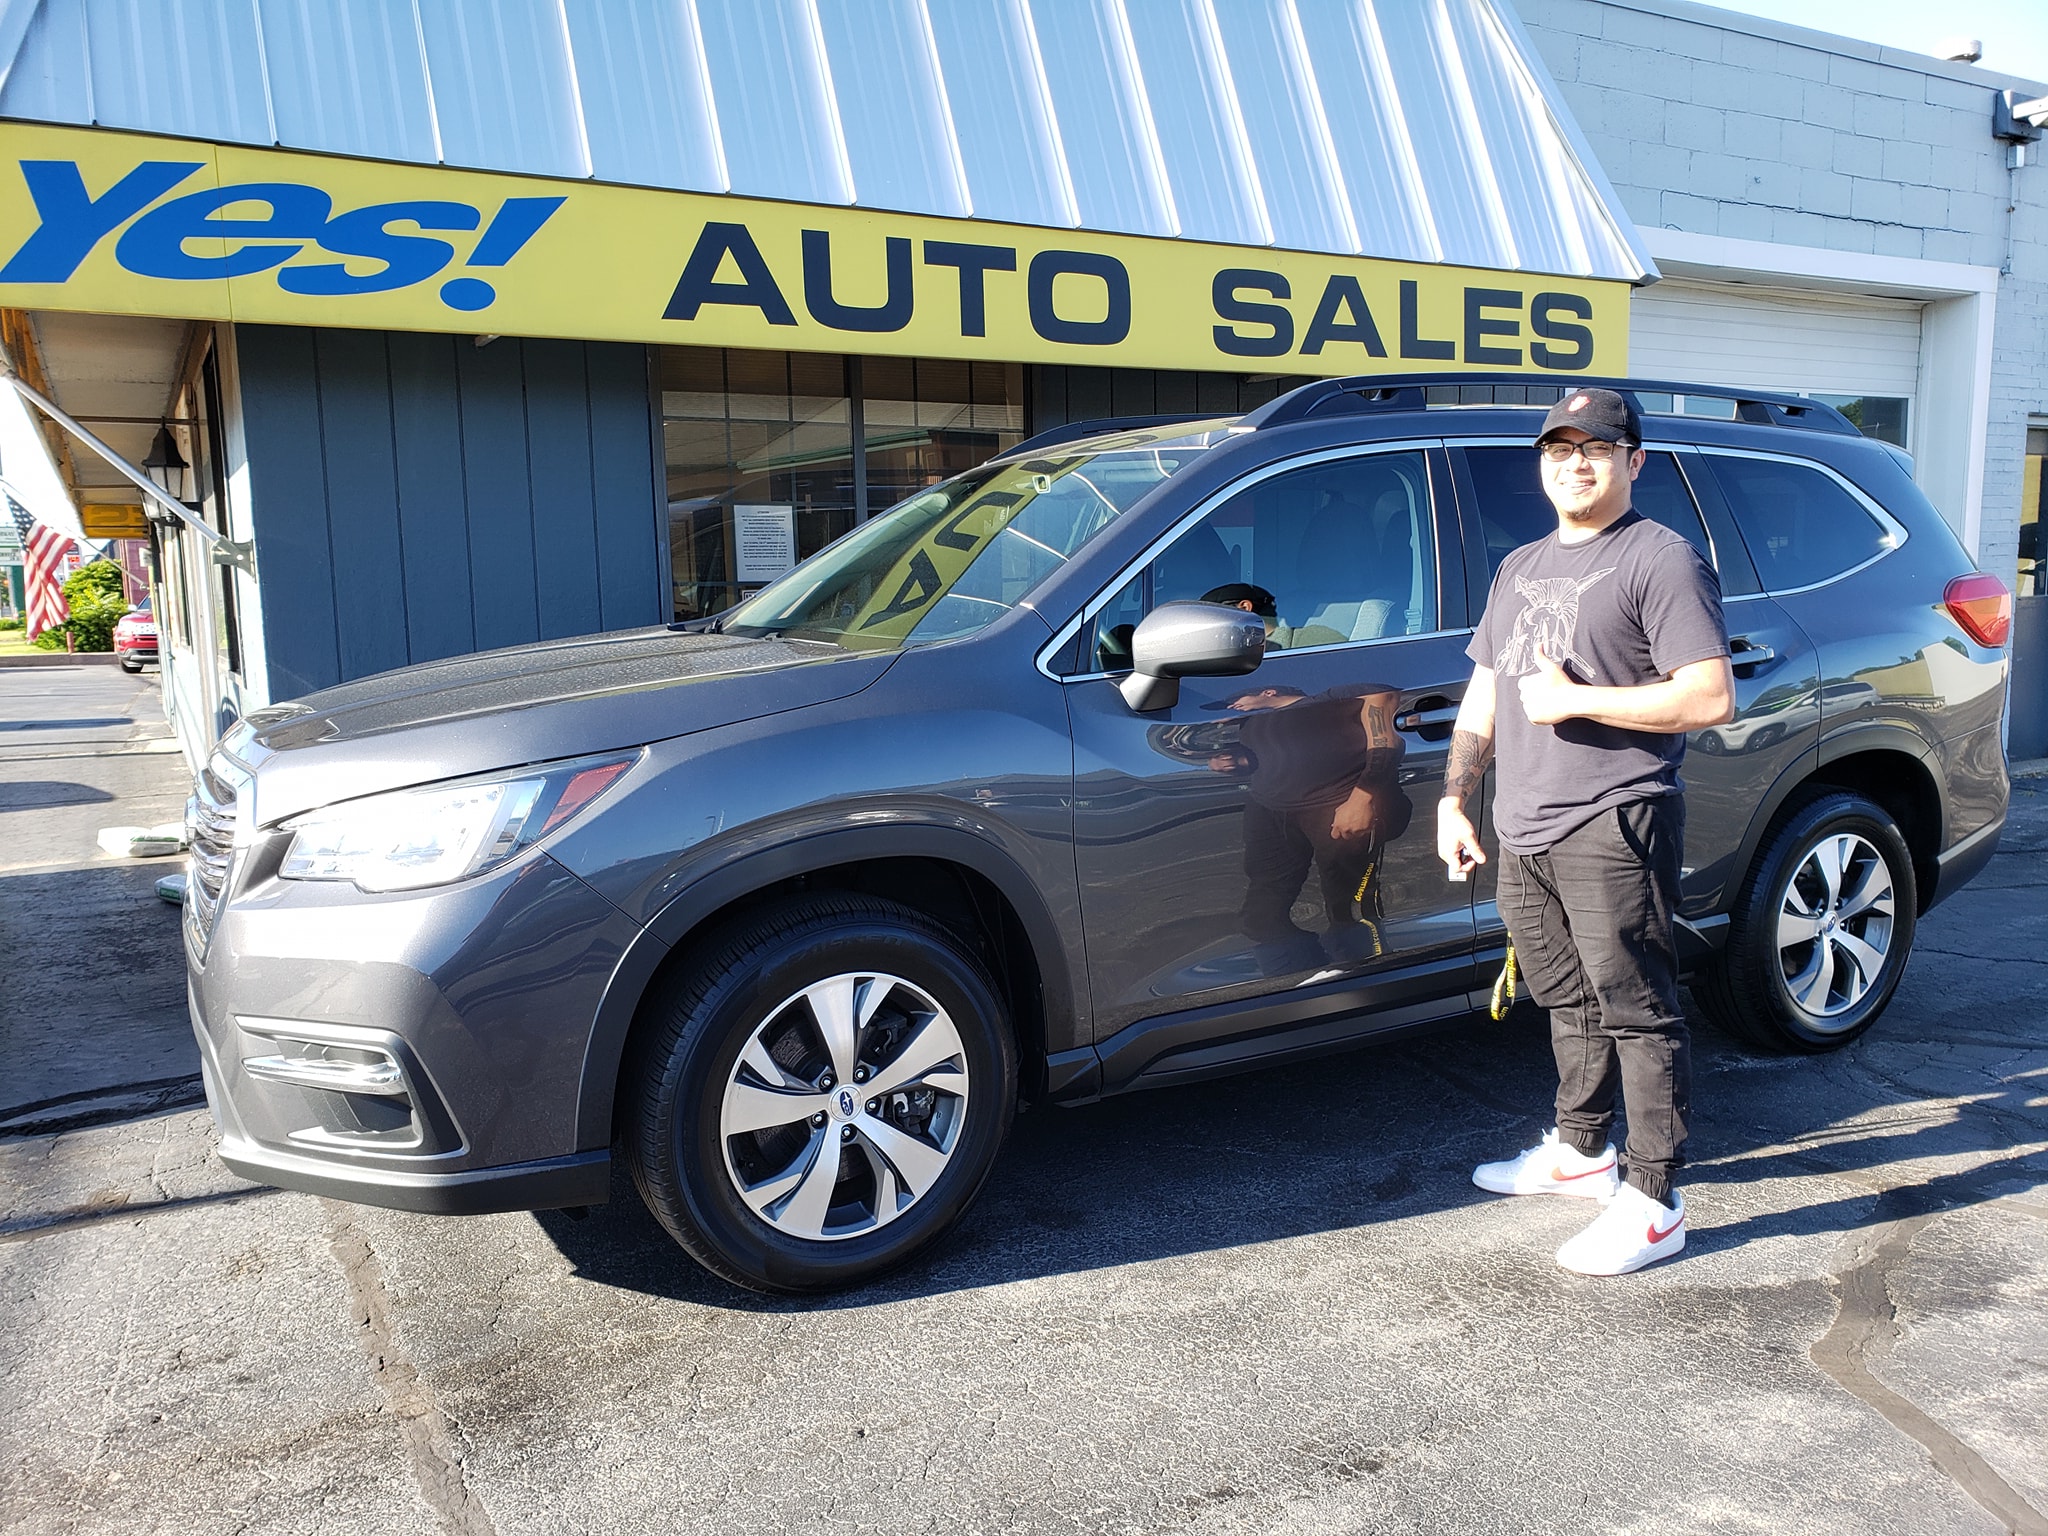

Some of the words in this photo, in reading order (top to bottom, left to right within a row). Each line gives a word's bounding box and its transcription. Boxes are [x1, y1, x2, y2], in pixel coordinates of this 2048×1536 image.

[0, 159, 569, 312] Yes!
[661, 221, 1132, 345] AUTO
[1211, 268, 1594, 371] SALES
